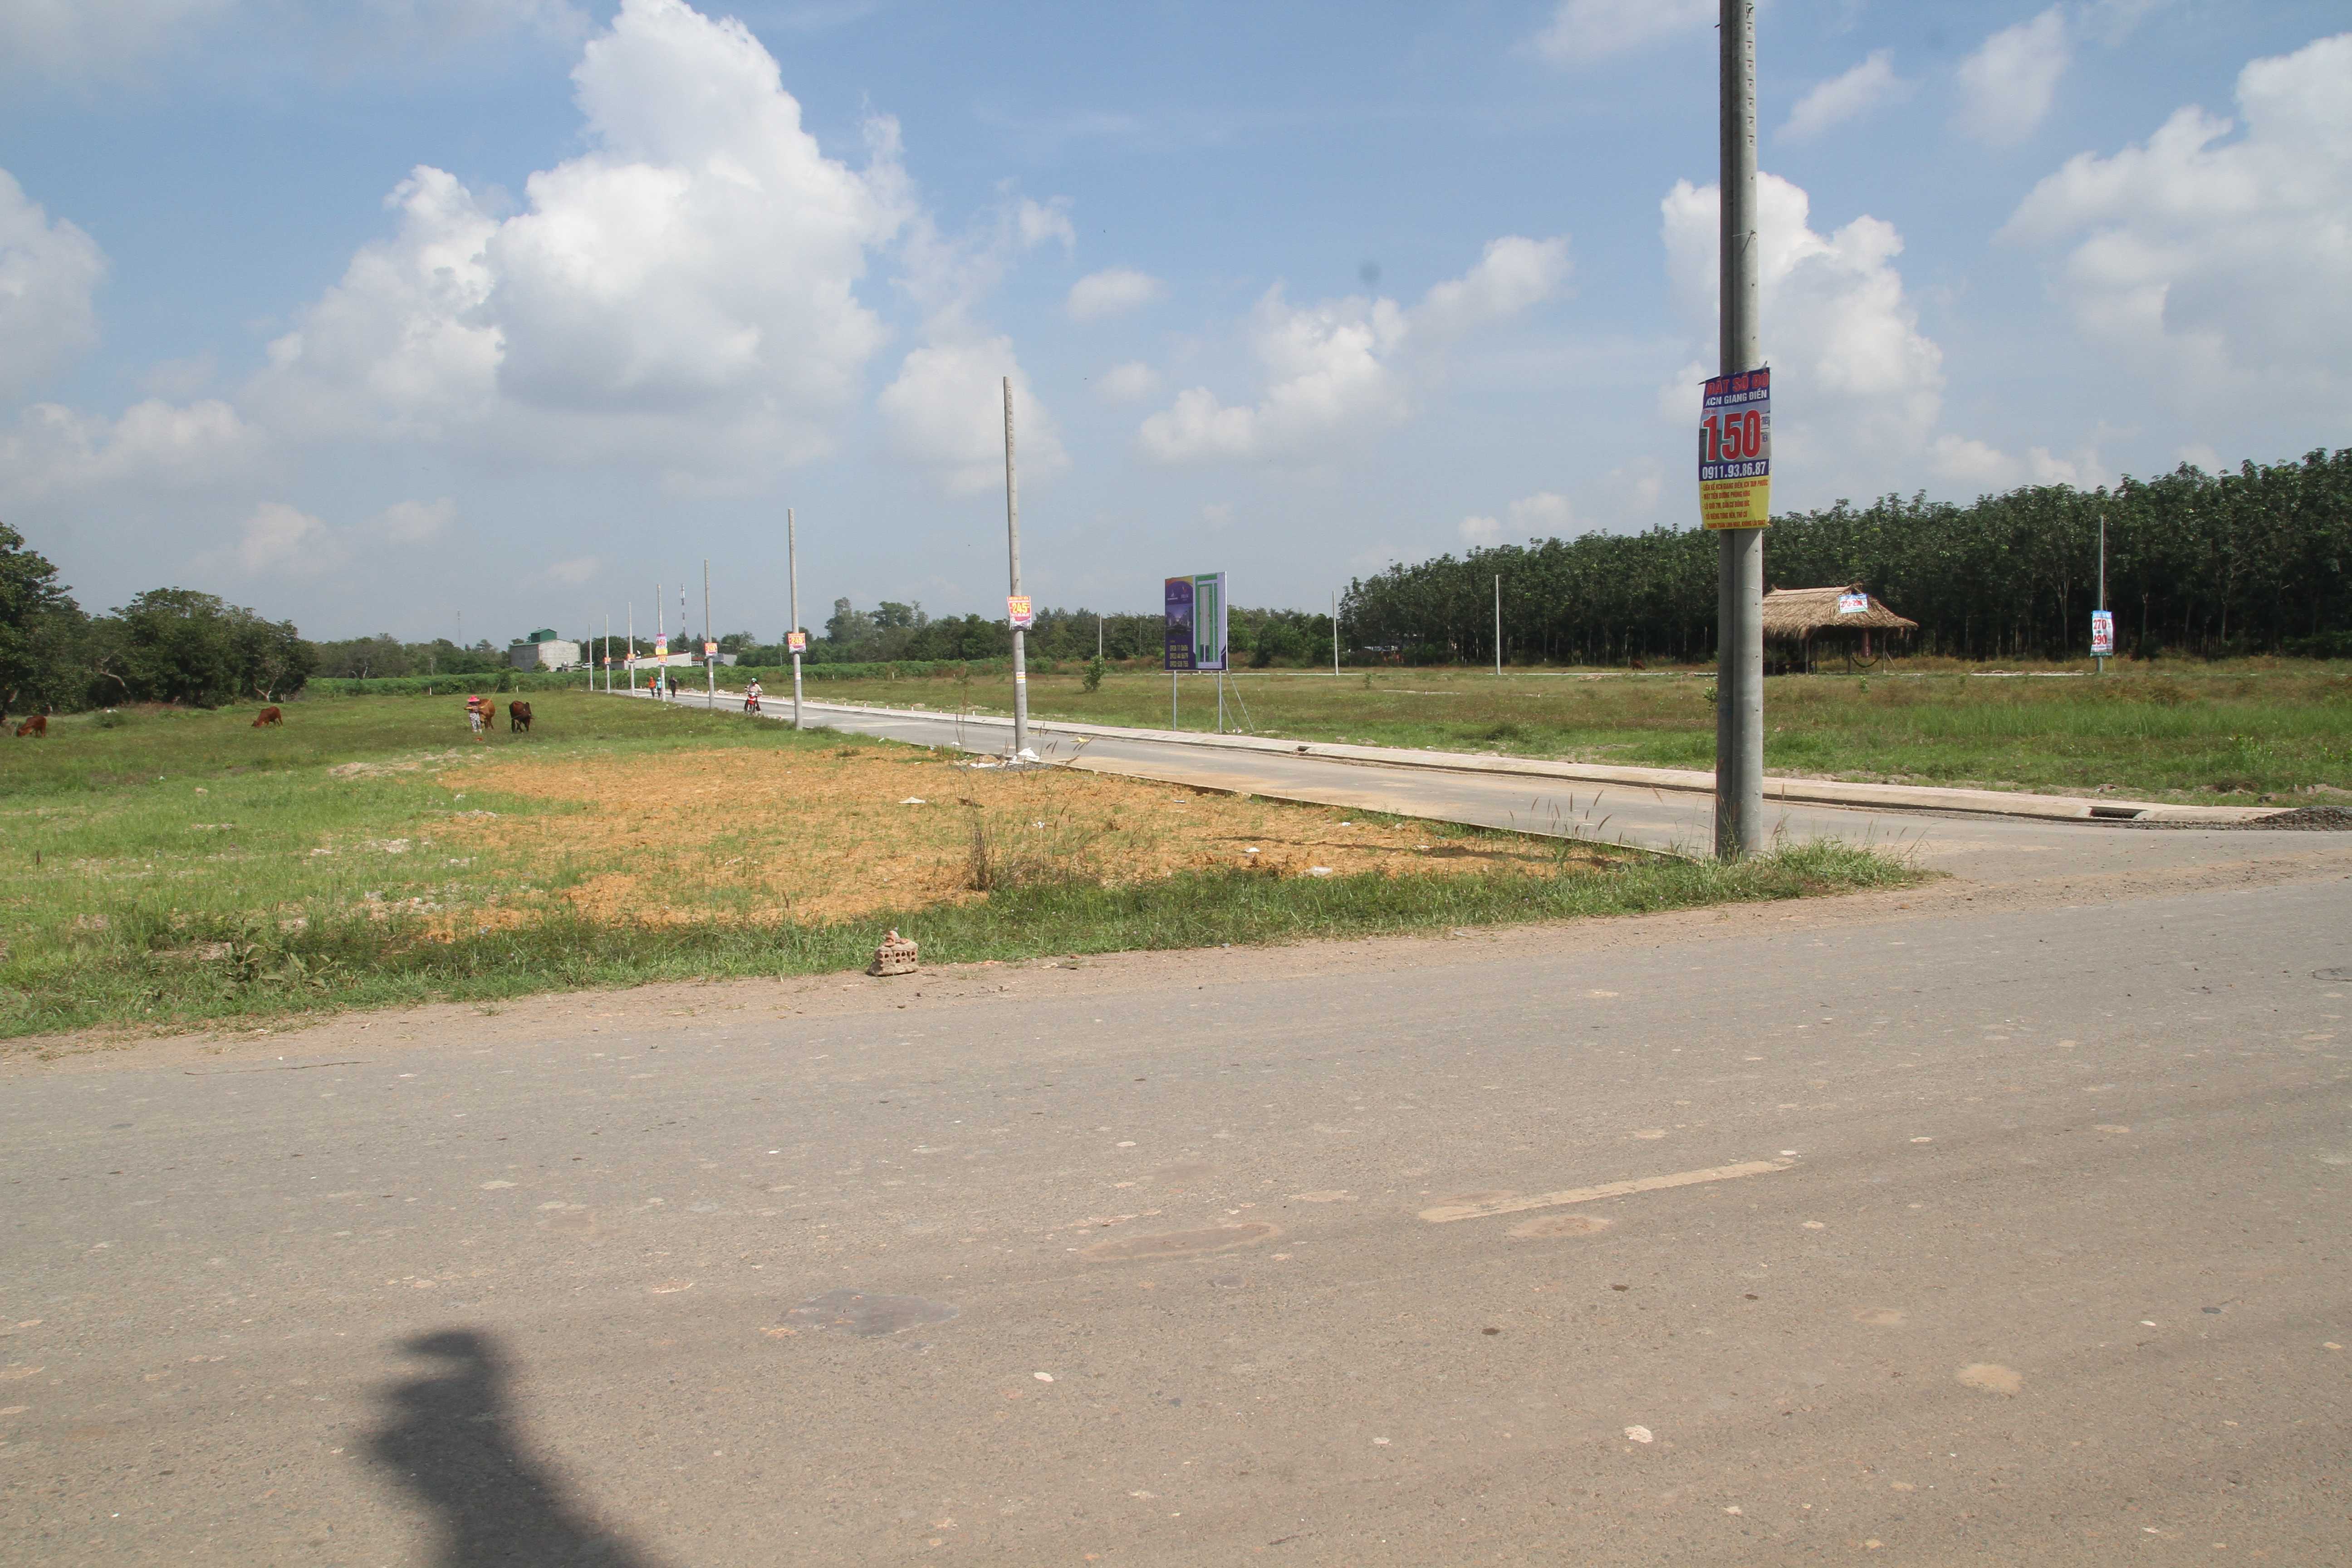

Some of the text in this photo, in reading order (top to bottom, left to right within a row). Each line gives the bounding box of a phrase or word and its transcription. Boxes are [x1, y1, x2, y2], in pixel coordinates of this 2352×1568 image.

[1705, 397, 1722, 407] KCN
[1725, 392, 1747, 404] GIANG
[1702, 409, 1761, 462] 150
[1702, 461, 1766, 480] 0911.93.86.87
[1012, 603, 1028, 613] 245
[2093, 619, 2107, 629] 270
[2092, 634, 2107, 645] 290
